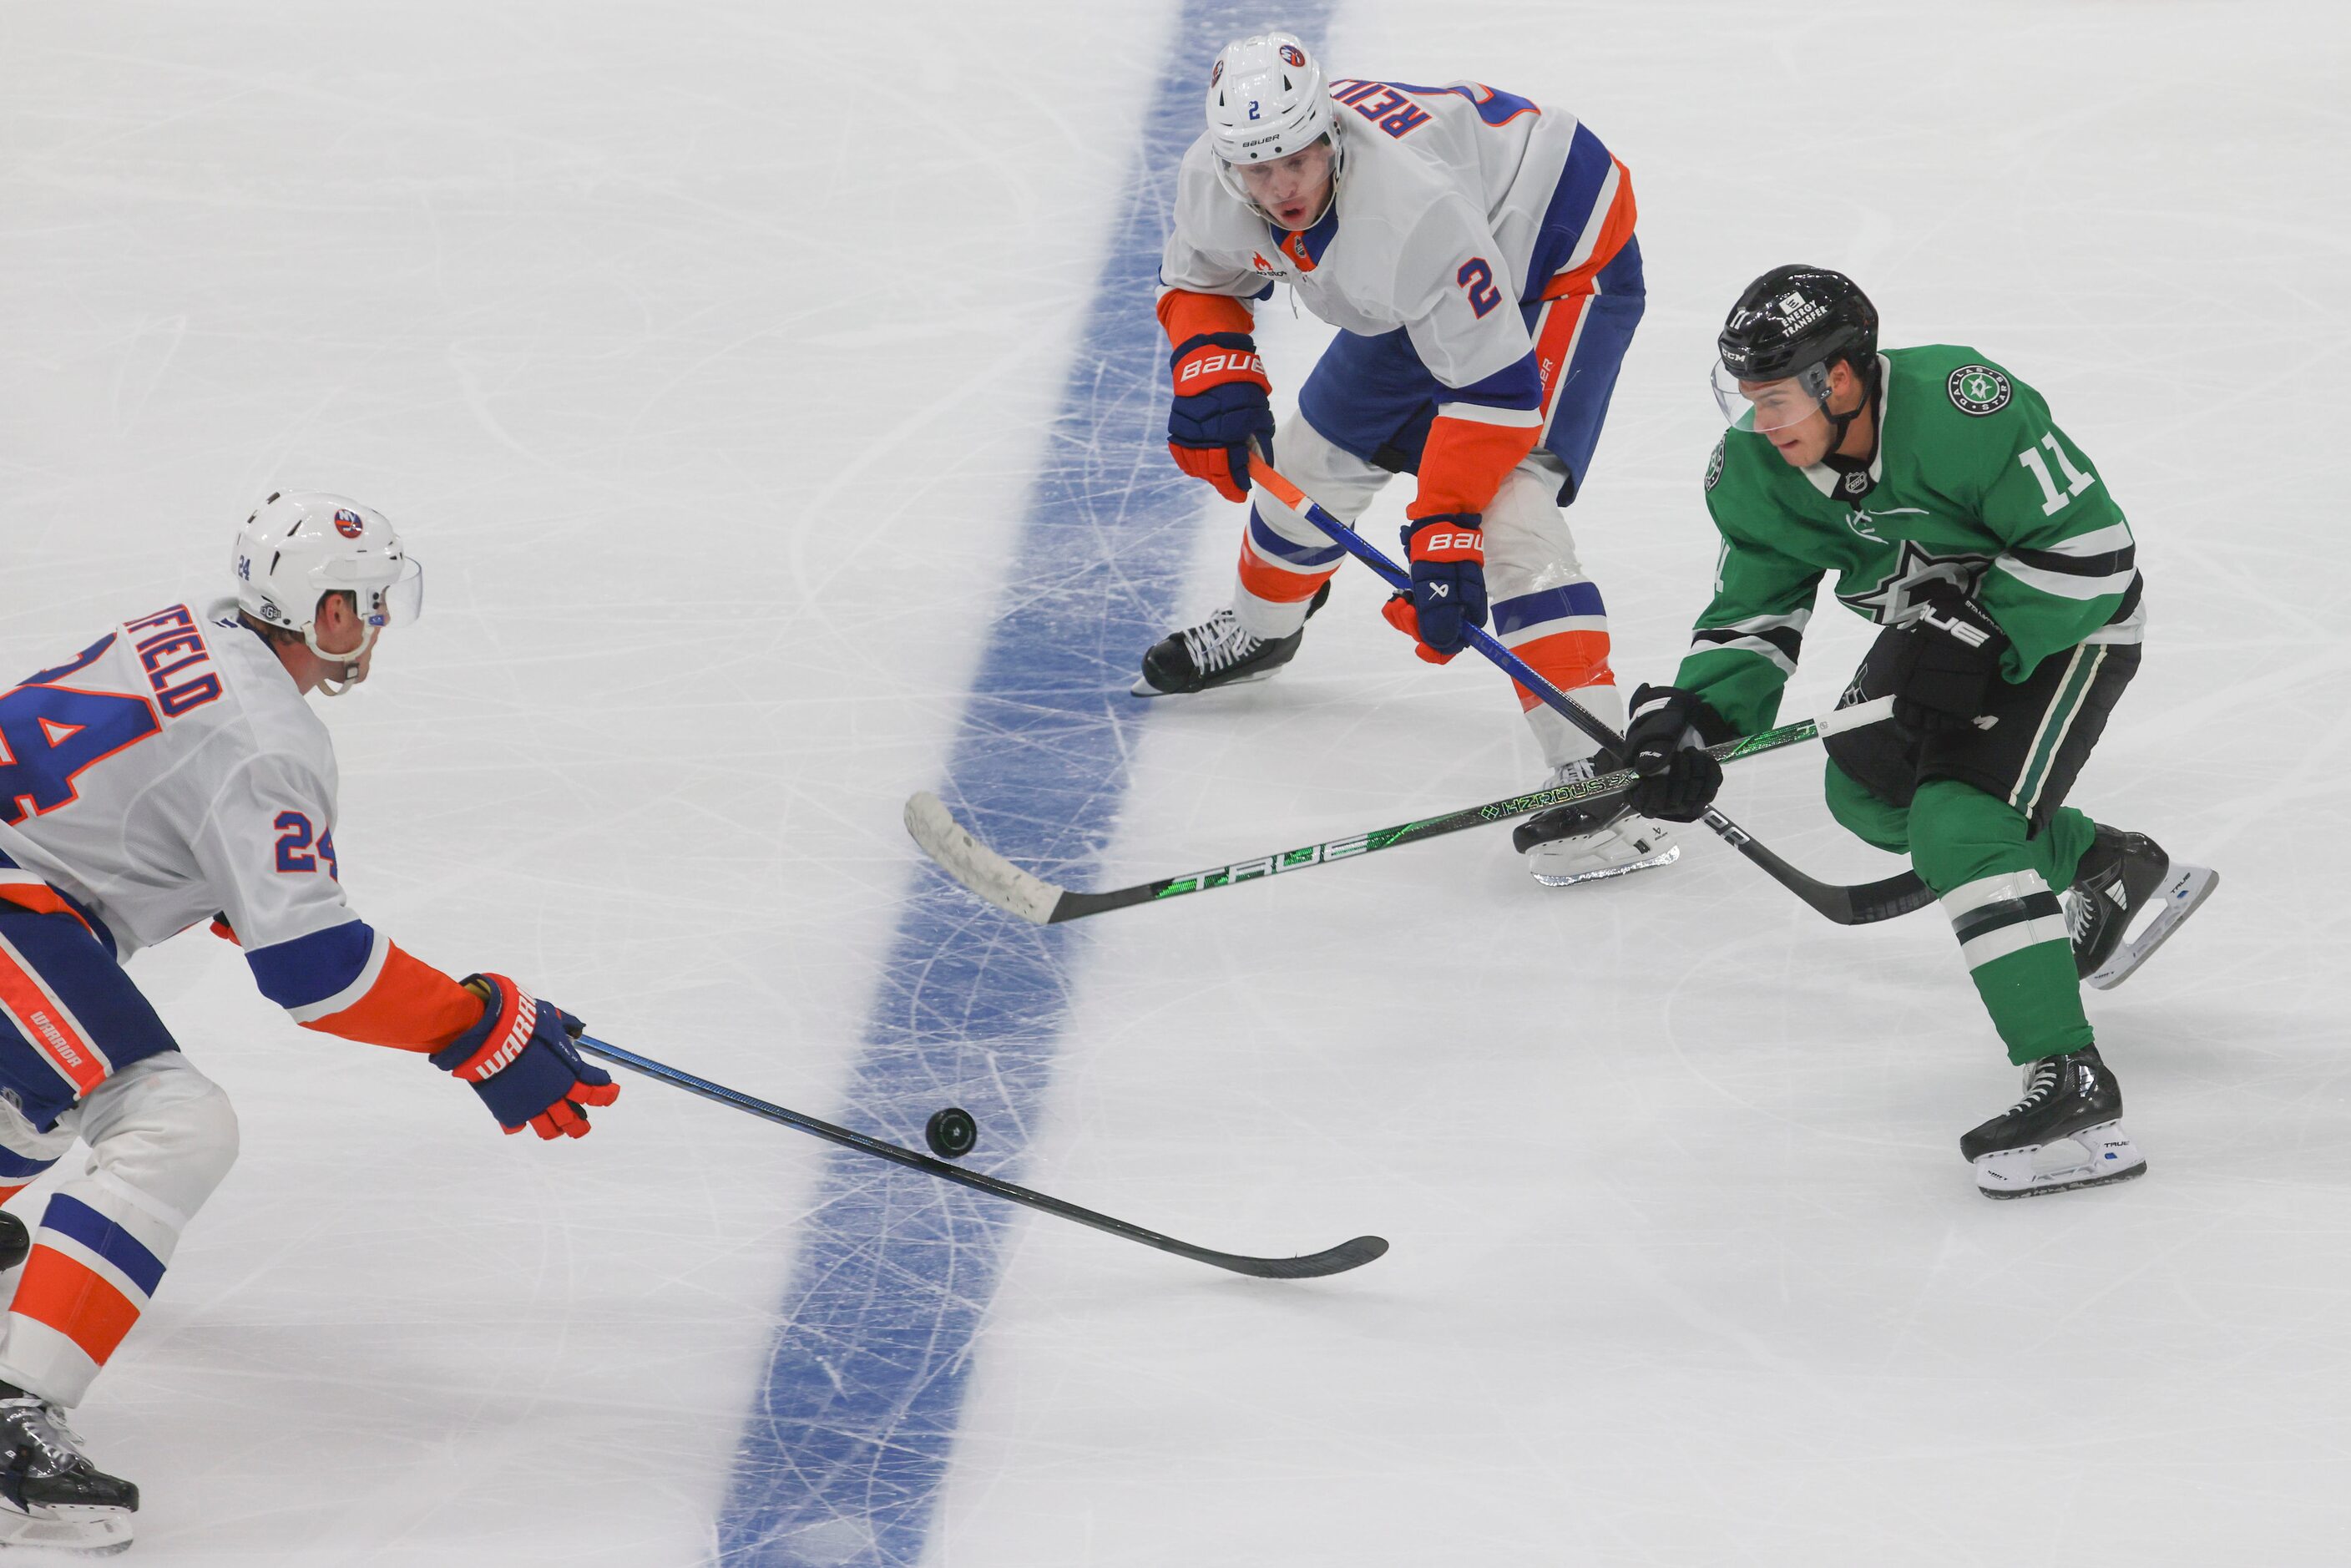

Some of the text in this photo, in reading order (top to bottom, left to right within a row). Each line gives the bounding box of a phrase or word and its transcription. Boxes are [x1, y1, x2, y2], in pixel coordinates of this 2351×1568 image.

[1248, 100, 1260, 120] 2
[1329, 79, 1433, 139] REIL
[1242, 134, 1280, 148] BAUER
[1456, 256, 1502, 320] 2
[1729, 310, 1750, 330] 11
[1781, 299, 1818, 327] ENERGY
[1782, 305, 1828, 337] TRANSFER
[1722, 349, 1746, 362] CCM
[1952, 367, 2008, 411] DALLAS STARS
[2018, 431, 2096, 517] 11
[238, 554, 250, 581] 24
[123, 603, 224, 718] FIELD
[0, 630, 163, 827] 4
[1171, 833, 1368, 891] TRUE
[1502, 776, 1606, 816] HZRDUS
[2171, 872, 2192, 894] TRUE
[30, 1010, 83, 1068] WARRIOR
[2103, 1140, 2131, 1148] TRUE
